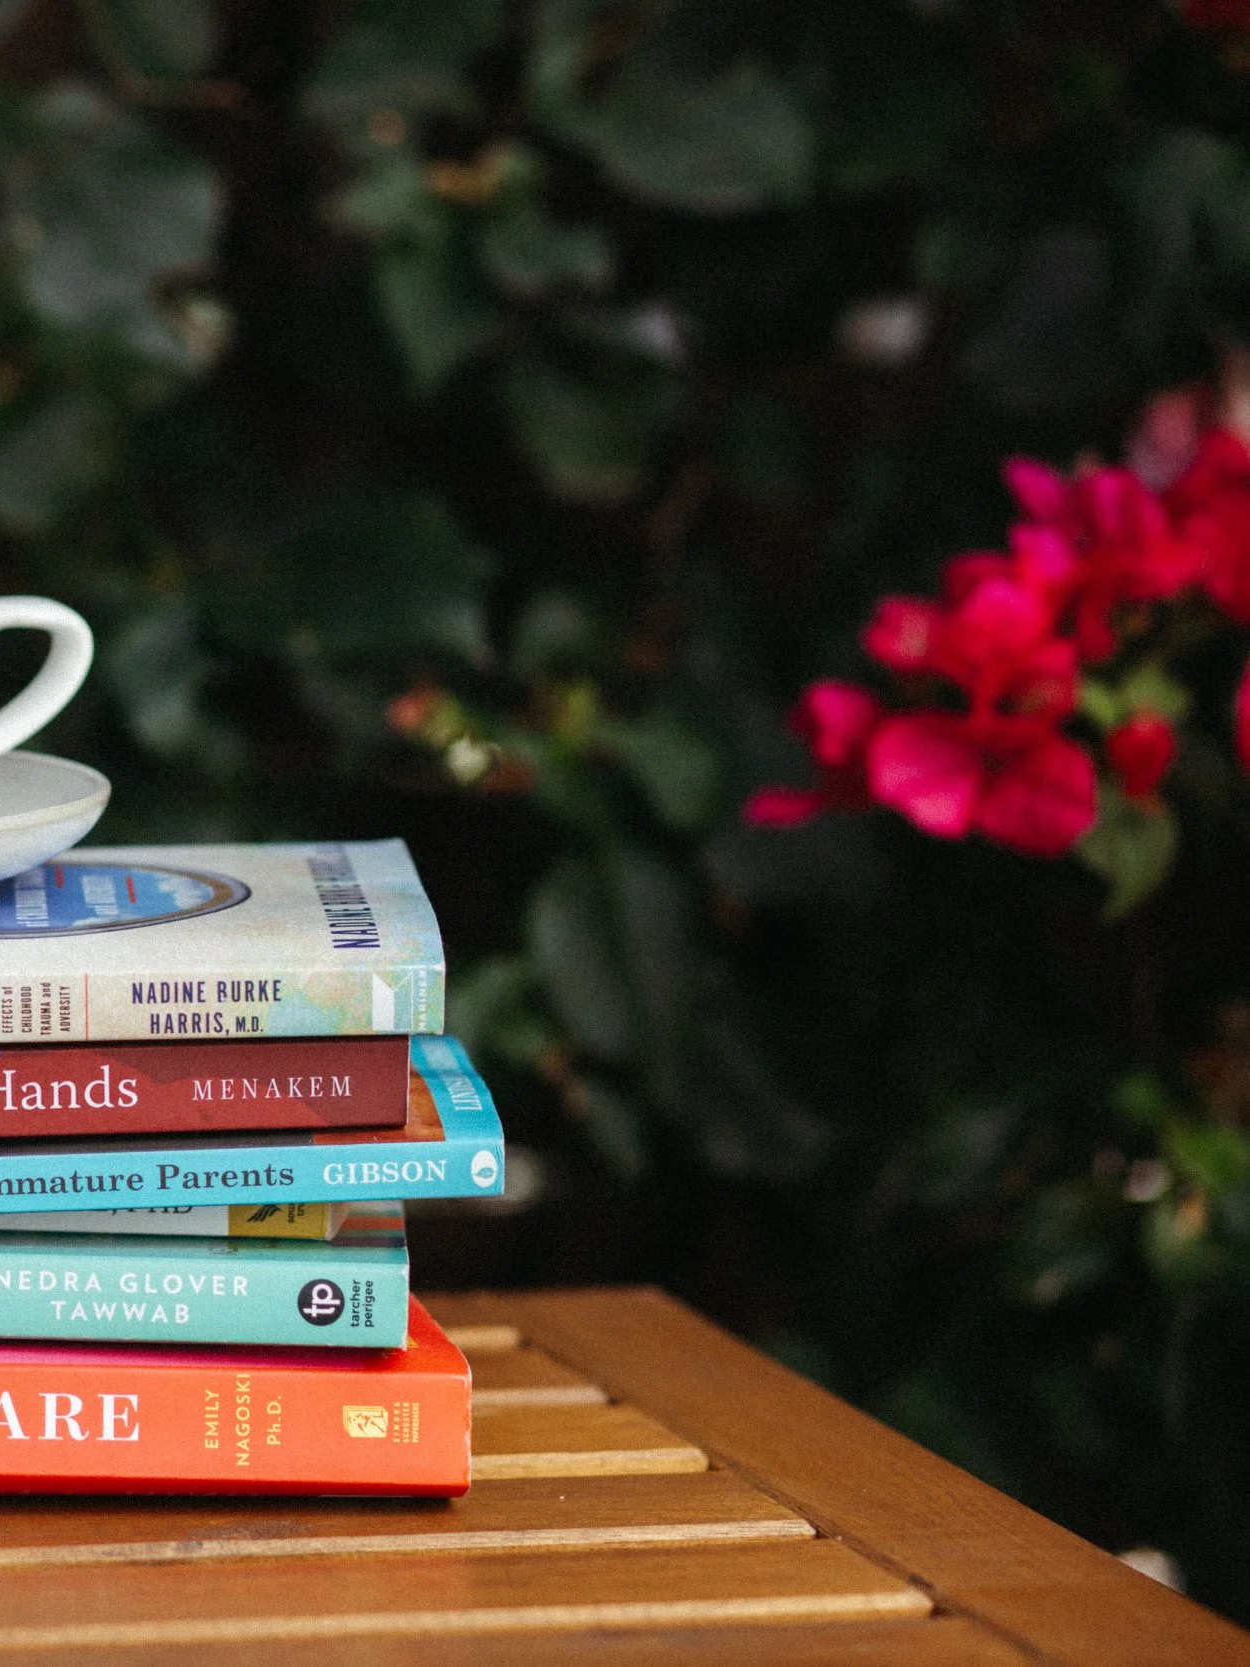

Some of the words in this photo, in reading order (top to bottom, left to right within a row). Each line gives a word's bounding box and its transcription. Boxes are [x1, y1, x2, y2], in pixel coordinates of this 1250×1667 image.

[2, 986, 13, 995] of
[39, 982, 51, 998] and
[131, 980, 206, 1005] NADINE
[217, 980, 282, 1003] BURKE
[1, 998, 13, 1034] EFFECTS
[21, 986, 33, 1033] CHILDHOOD
[40, 1001, 52, 1036] TRAUMA
[59, 985, 71, 1032] ADVERSITY
[150, 1013, 231, 1036] HARRIS,
[235, 1014, 264, 1034] M.D.
[192, 1075, 353, 1101] MENAKEM
[156, 1162, 295, 1190] Parents
[323, 1159, 448, 1186] GIBSON
[119, 1273, 249, 1297] GLOVER
[302, 1283, 341, 1317] tp
[51, 1300, 190, 1325] TAWWAB
[350, 1279, 361, 1328] tarcher
[362, 1280, 375, 1328] perigee
[205, 1388, 220, 1449] EMILY
[236, 1373, 251, 1466] NAGOSKI
[267, 1395, 282, 1445] Ph.D.
[403, 1402, 411, 1443] SCHUSTER
